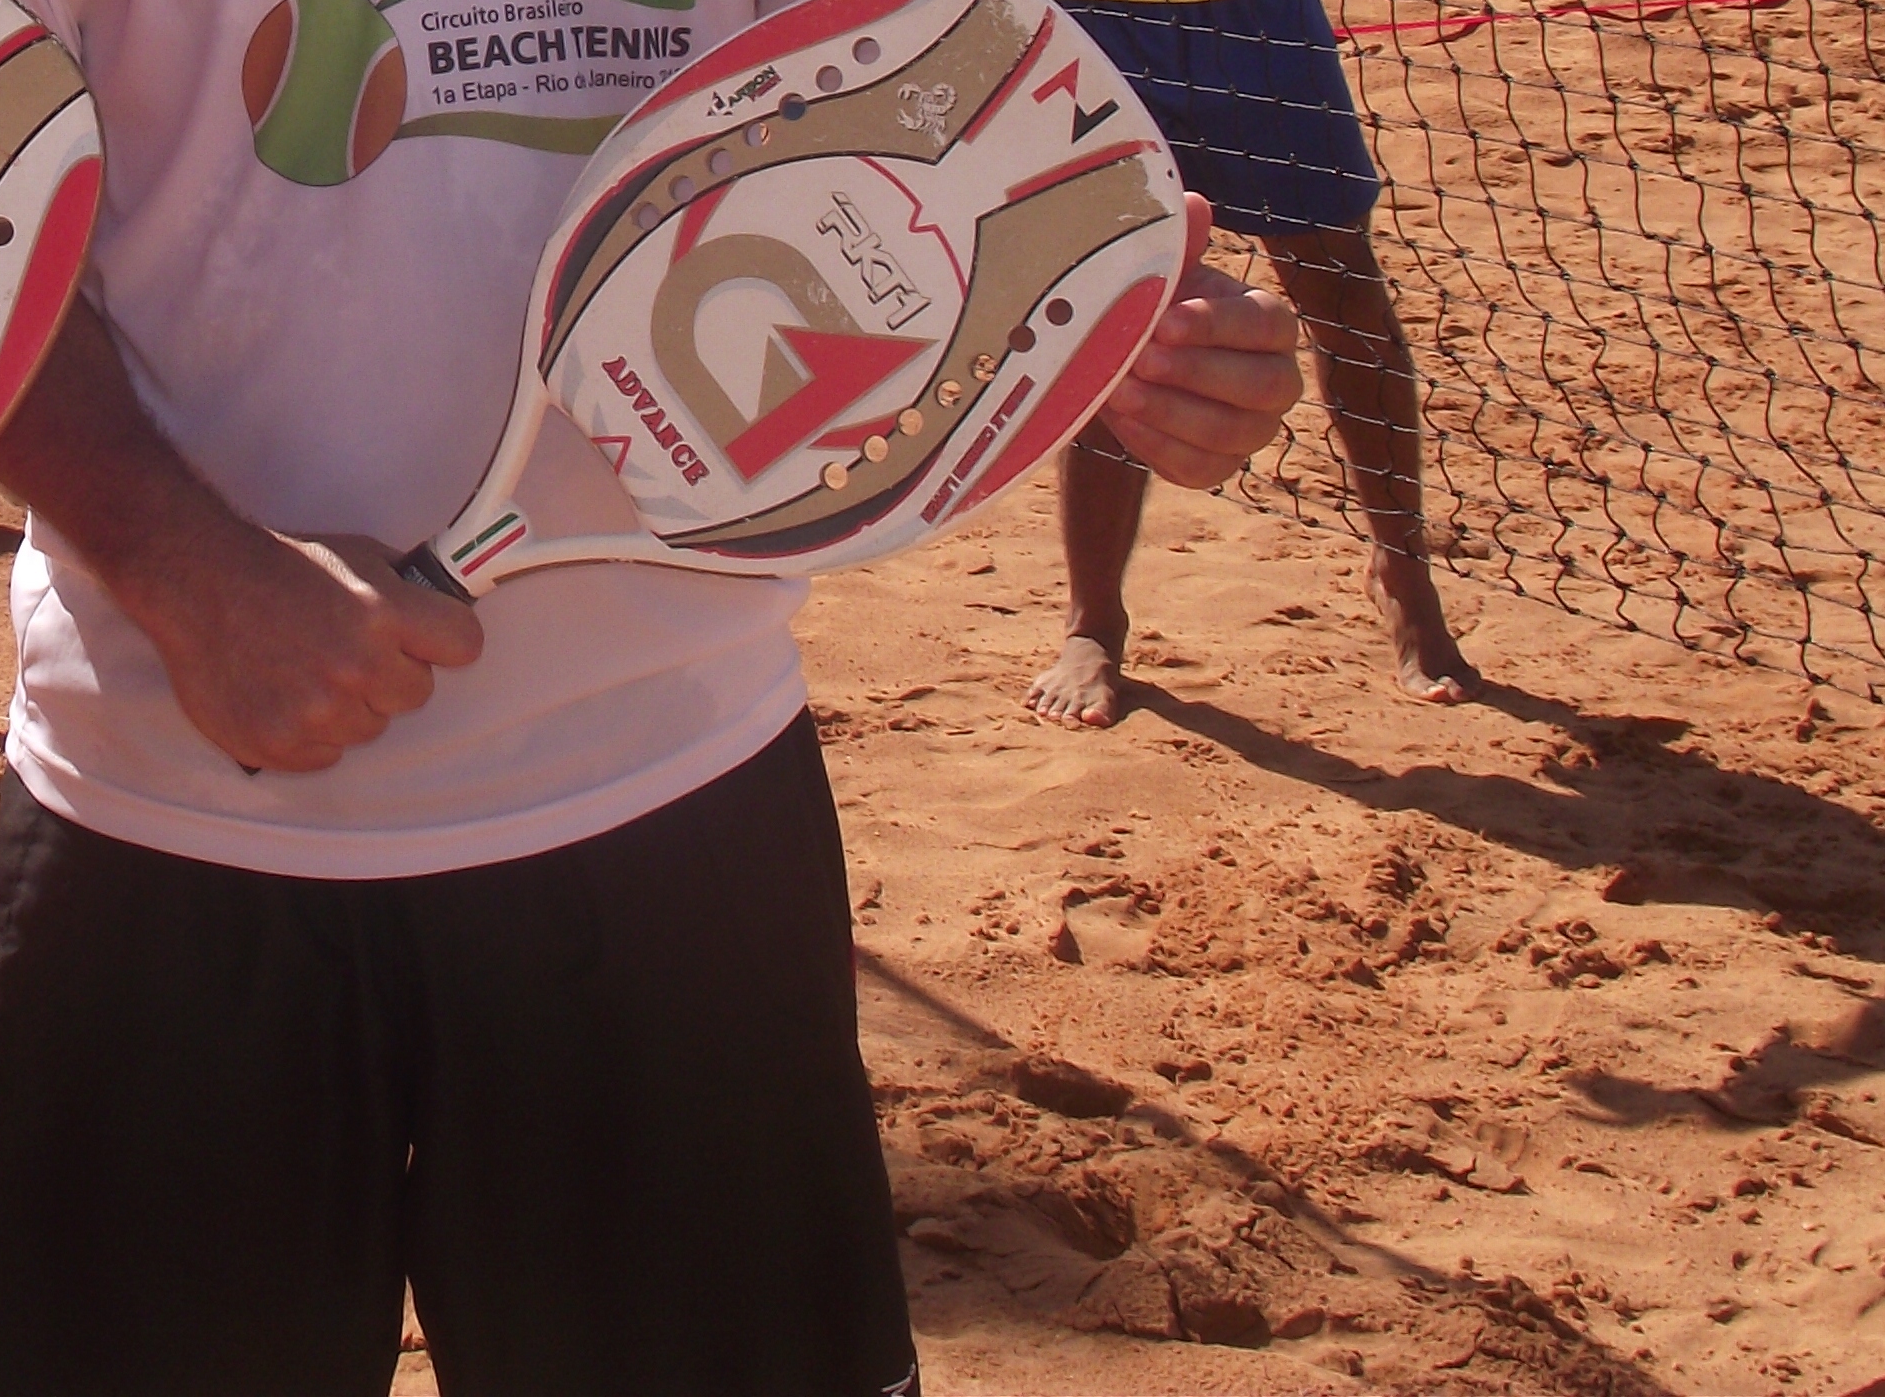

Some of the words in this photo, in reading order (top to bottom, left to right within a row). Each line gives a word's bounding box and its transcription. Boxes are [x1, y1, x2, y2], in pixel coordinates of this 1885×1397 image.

[421, 7, 500, 32] Circuito
[427, 29, 567, 76] BEACH
[570, 25, 693, 61] TENNIS
[431, 85, 456, 105] 1a
[462, 80, 517, 104] Etapa
[535, 73, 569, 93] Rio
[588, 68, 655, 90] Janeiro
[601, 355, 711, 487] ADVANCE
